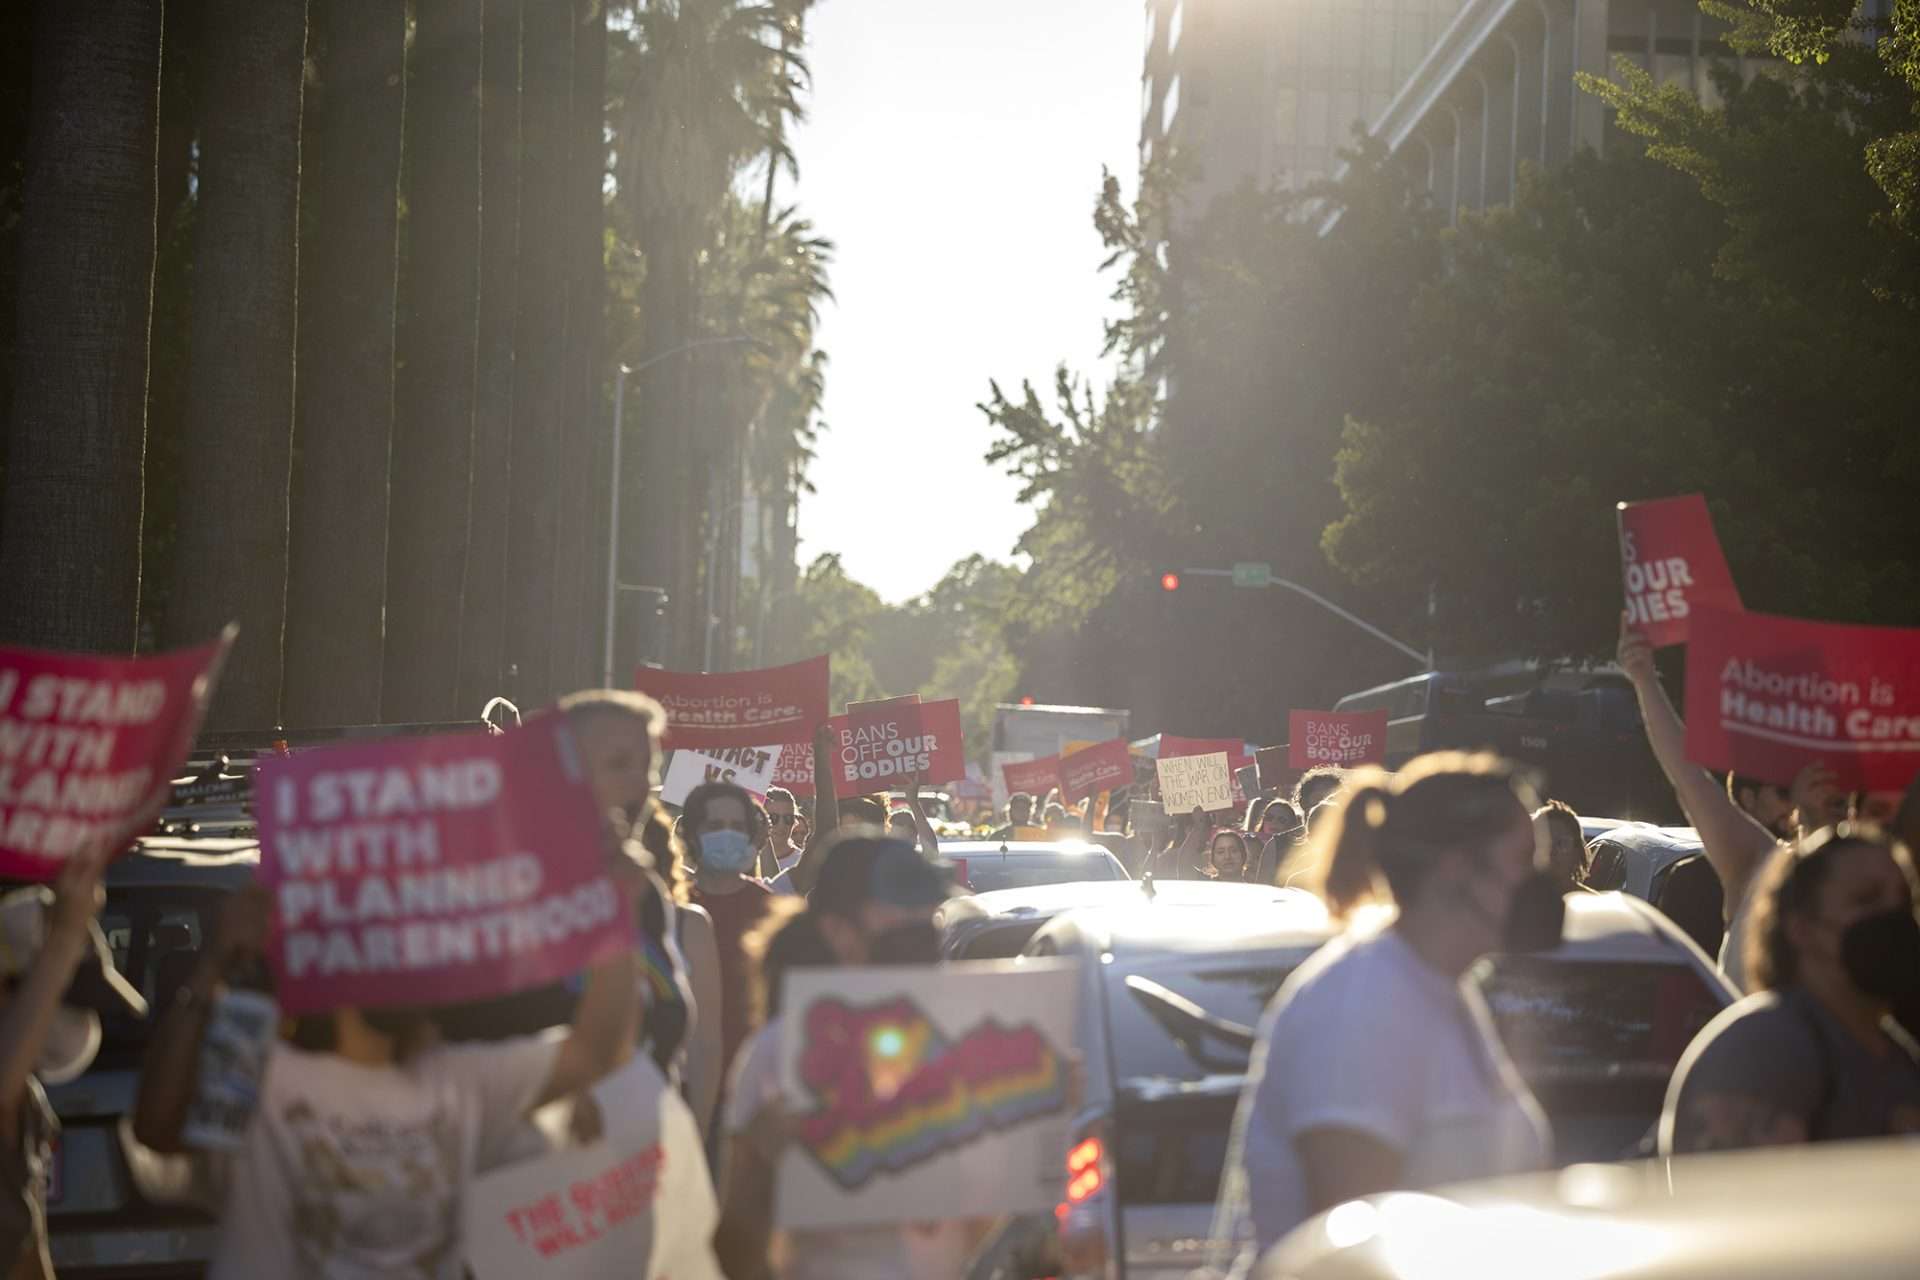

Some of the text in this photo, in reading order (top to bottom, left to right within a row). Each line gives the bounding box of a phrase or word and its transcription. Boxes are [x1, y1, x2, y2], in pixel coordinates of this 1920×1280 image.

[1627, 557, 1693, 593] OUR
[1720, 656, 1895, 706] Abortion is
[22, 673, 166, 725] STAND
[661, 692, 772, 710] Abortion is
[1721, 688, 1836, 737] Health
[840, 722, 899, 746] BANS
[1306, 721, 1350, 737] BANS
[1306, 734, 1372, 749] OFF OUR
[781, 743, 814, 756] ANS
[841, 742, 883, 764] OFF
[886, 734, 938, 757] OUR
[1306, 746, 1366, 760] BODIES
[772, 769, 814, 784] BODI
[844, 752, 931, 782] BODIES
[1161, 771, 1185, 788] THE
[1188, 769, 1210, 786] WAR
[1162, 756, 1222, 775] WHEN WILL
[275, 757, 502, 824] I STAND
[1165, 788, 1205, 807] WOMEN
[276, 818, 438, 876] WITH
[279, 852, 544, 926] PLANNED
[285, 878, 620, 976] PARENTHOOD
